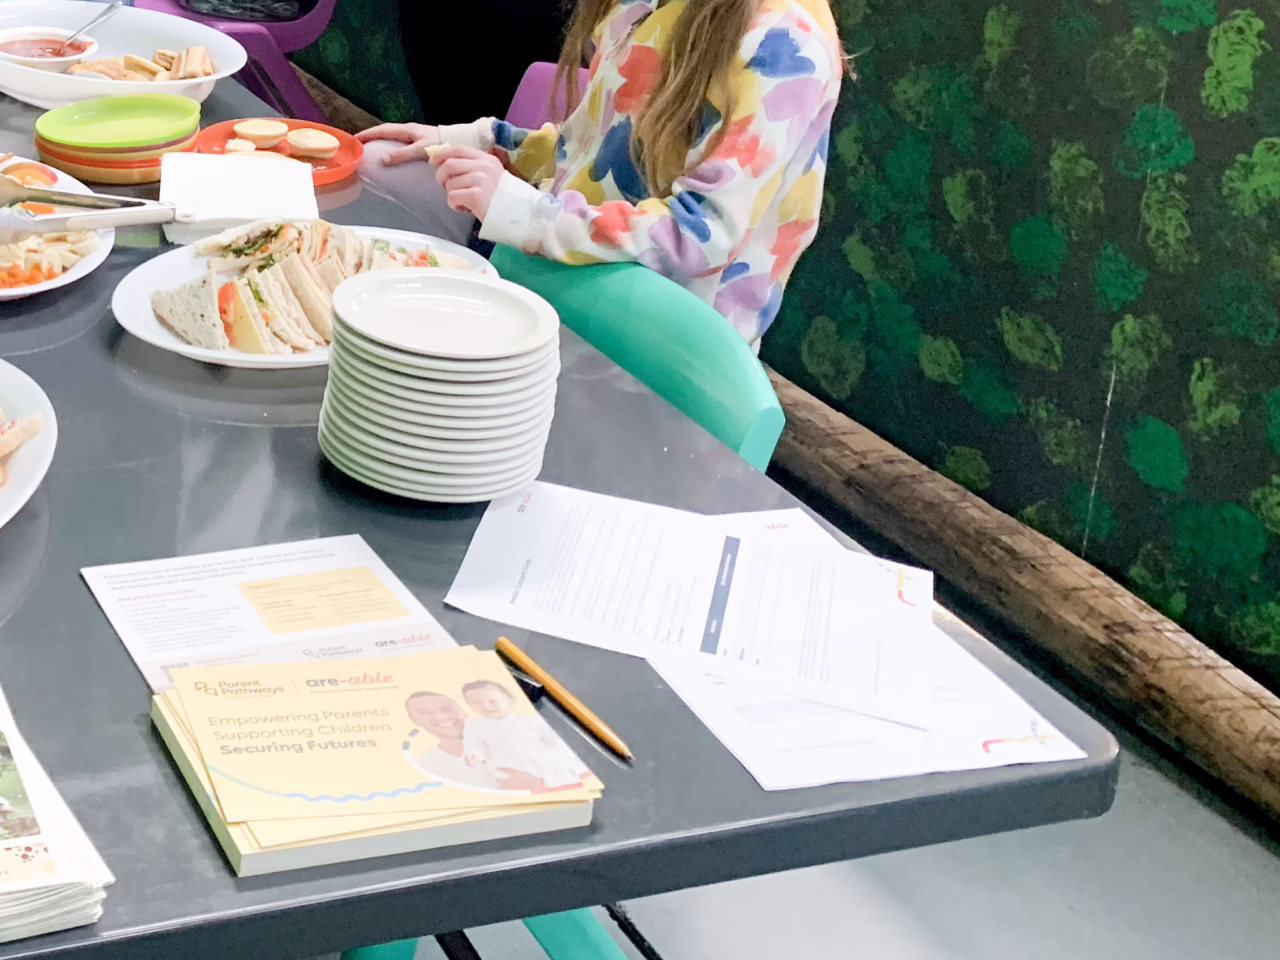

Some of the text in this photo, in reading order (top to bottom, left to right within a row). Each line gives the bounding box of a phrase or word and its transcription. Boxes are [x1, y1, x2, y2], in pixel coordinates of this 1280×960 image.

[218, 680, 261, 689] Parent
[305, 672, 395, 688] are-able
[221, 685, 285, 696] Pathways
[208, 708, 390, 727] Empowering Parents
[213, 723, 392, 741] Supporting Children
[219, 739, 378, 755] Securing Futures
